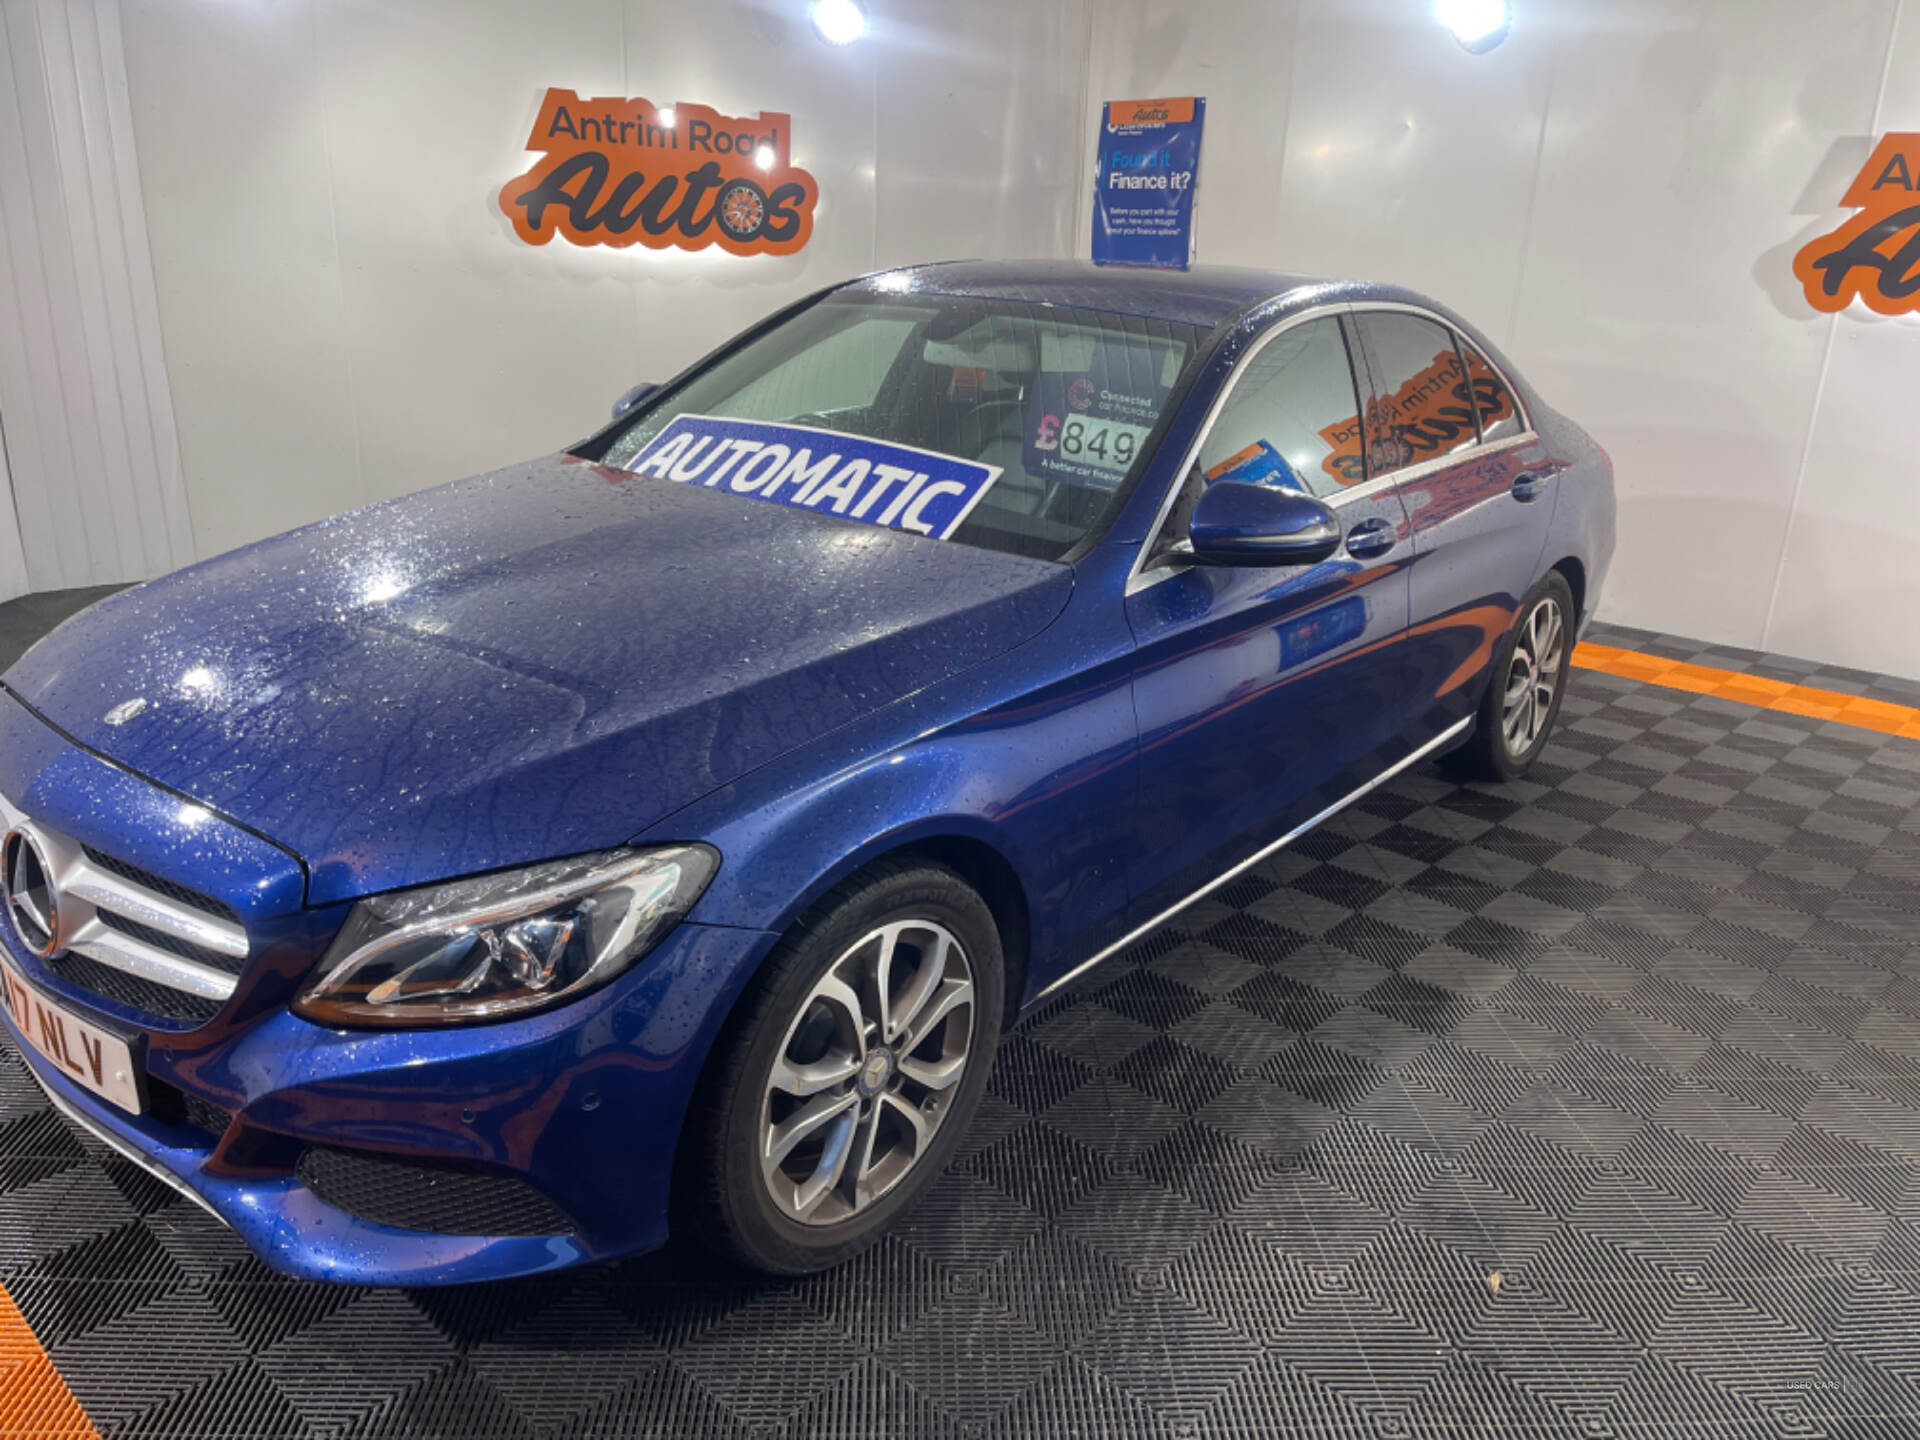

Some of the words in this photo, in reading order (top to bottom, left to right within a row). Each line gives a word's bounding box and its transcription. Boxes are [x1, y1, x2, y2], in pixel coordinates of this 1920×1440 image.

[548, 106, 677, 149] Antrim
[689, 120, 777, 155] Road
[1112, 152, 1156, 168] Found
[1159, 152, 1171, 167] it
[515, 152, 806, 242] Autos
[1110, 173, 1167, 189] Finance
[1171, 172, 1191, 189] it?
[637, 431, 968, 536] AUTOMATIC
[36, 1002, 103, 1087] NLV
